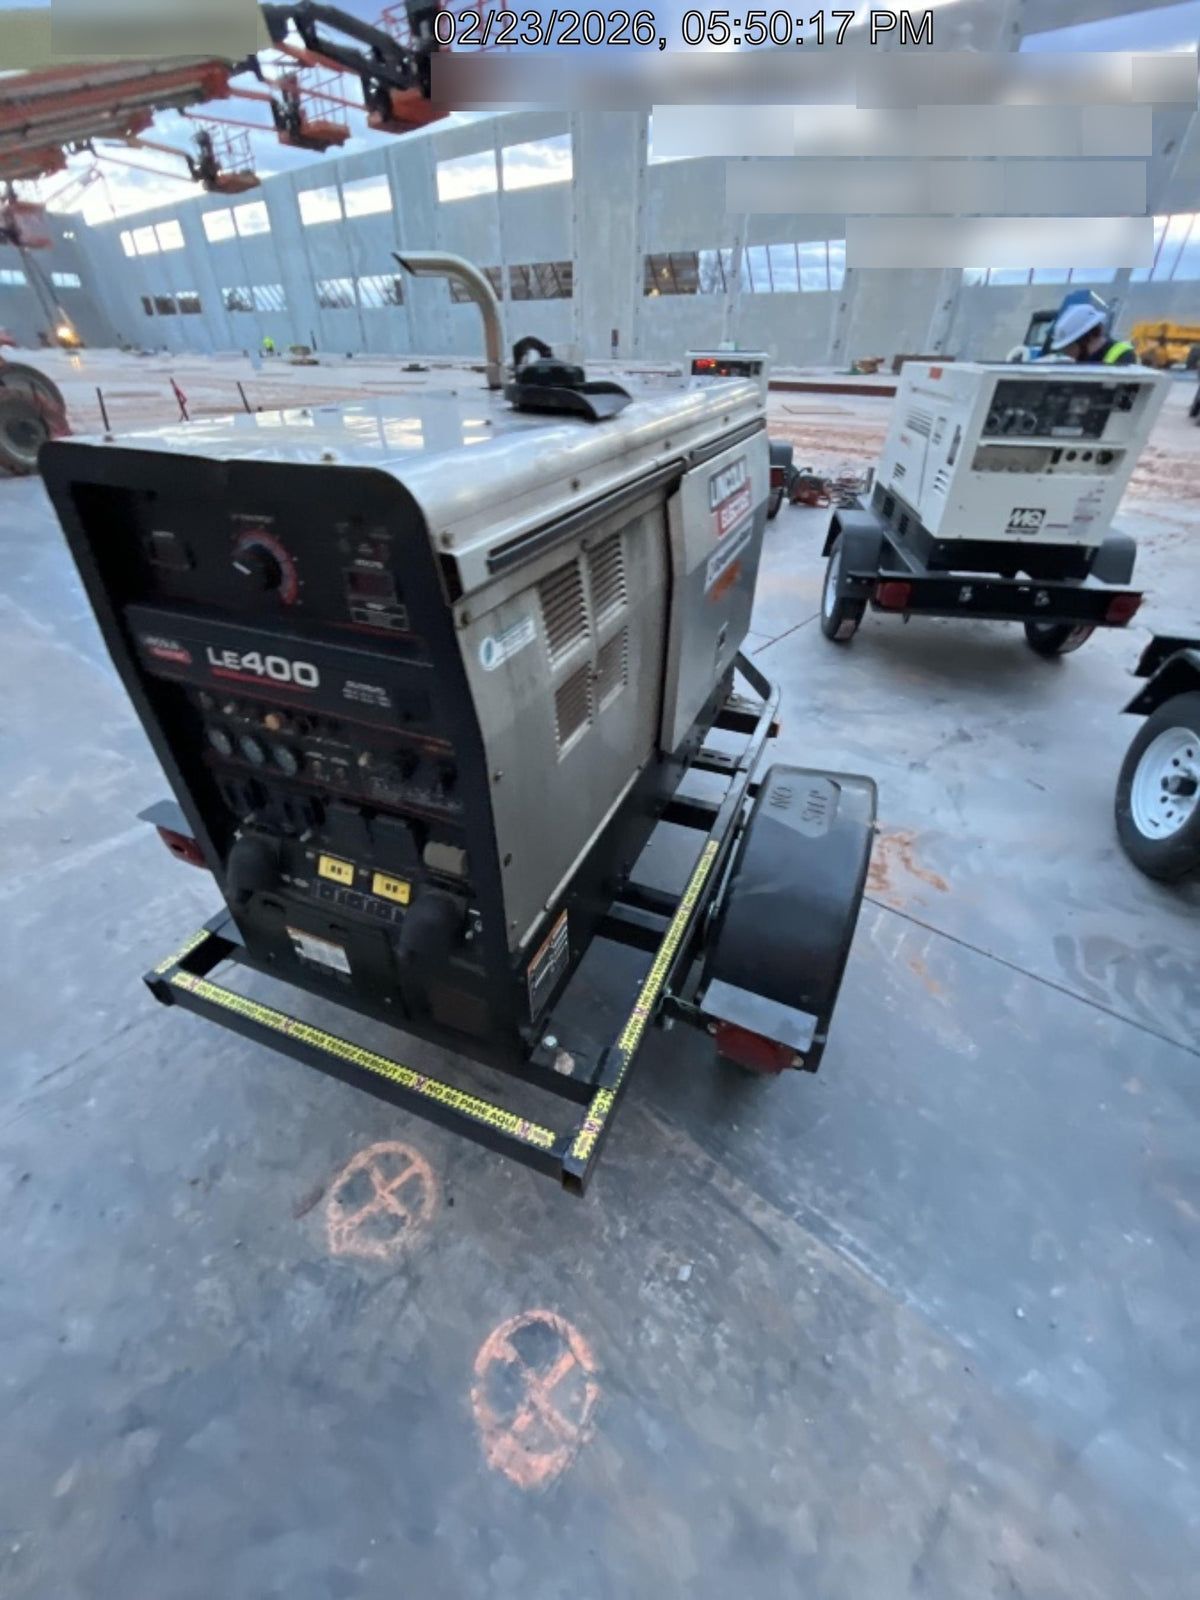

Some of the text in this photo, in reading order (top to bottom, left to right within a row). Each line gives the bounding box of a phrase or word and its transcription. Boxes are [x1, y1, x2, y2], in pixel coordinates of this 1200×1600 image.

[206, 646, 320, 688] LE400
[770, 786, 792, 810] NO
[426, 1083, 443, 1096] NO
